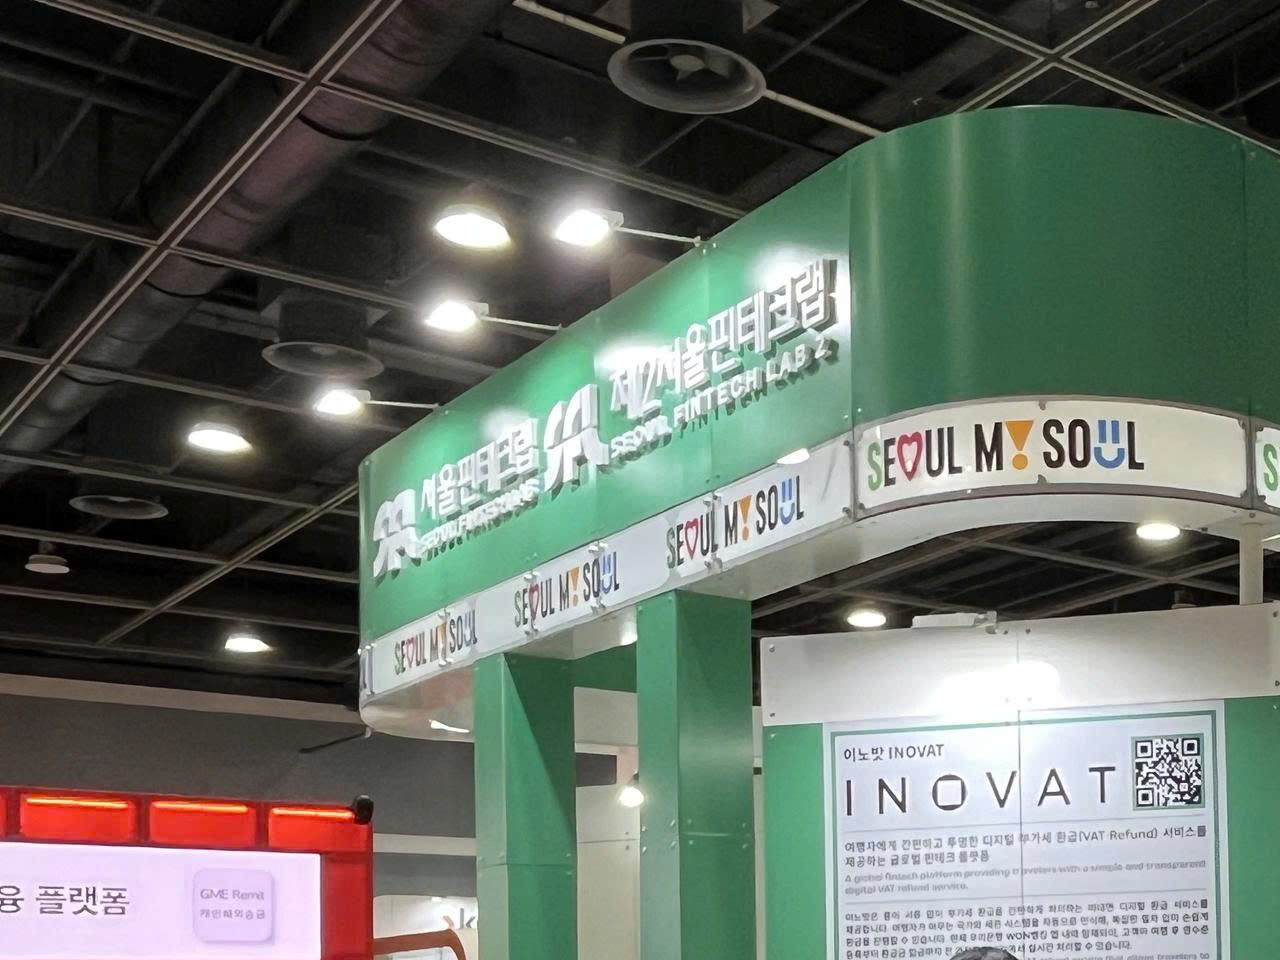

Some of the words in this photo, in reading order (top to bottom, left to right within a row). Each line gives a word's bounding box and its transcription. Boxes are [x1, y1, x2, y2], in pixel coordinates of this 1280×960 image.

[843, 746, 884, 762] 이노밧
[888, 743, 945, 761] INOVAT
[845, 766, 1117, 816] INOVAT
[35, 885, 130, 916] 플랫폼
